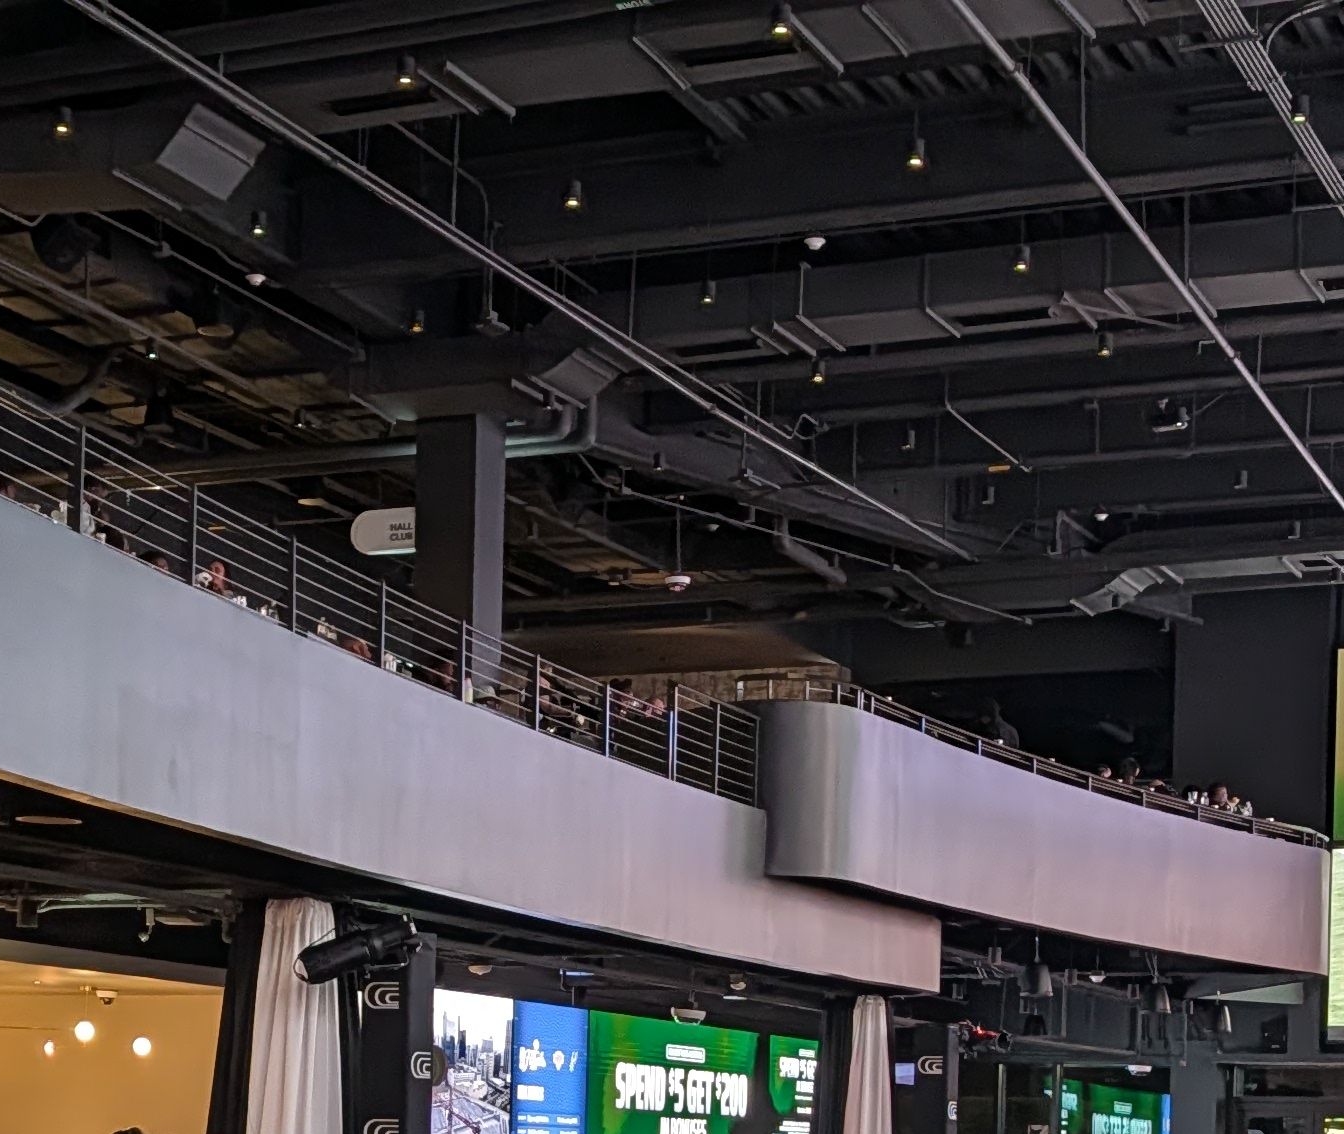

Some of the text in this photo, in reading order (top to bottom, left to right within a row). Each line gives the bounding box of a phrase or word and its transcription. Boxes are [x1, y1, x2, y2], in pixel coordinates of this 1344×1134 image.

[390, 522, 413, 532] HALL
[389, 532, 413, 542] CLUB
[615, 1061, 748, 1118] SPEND $5 GET $200
